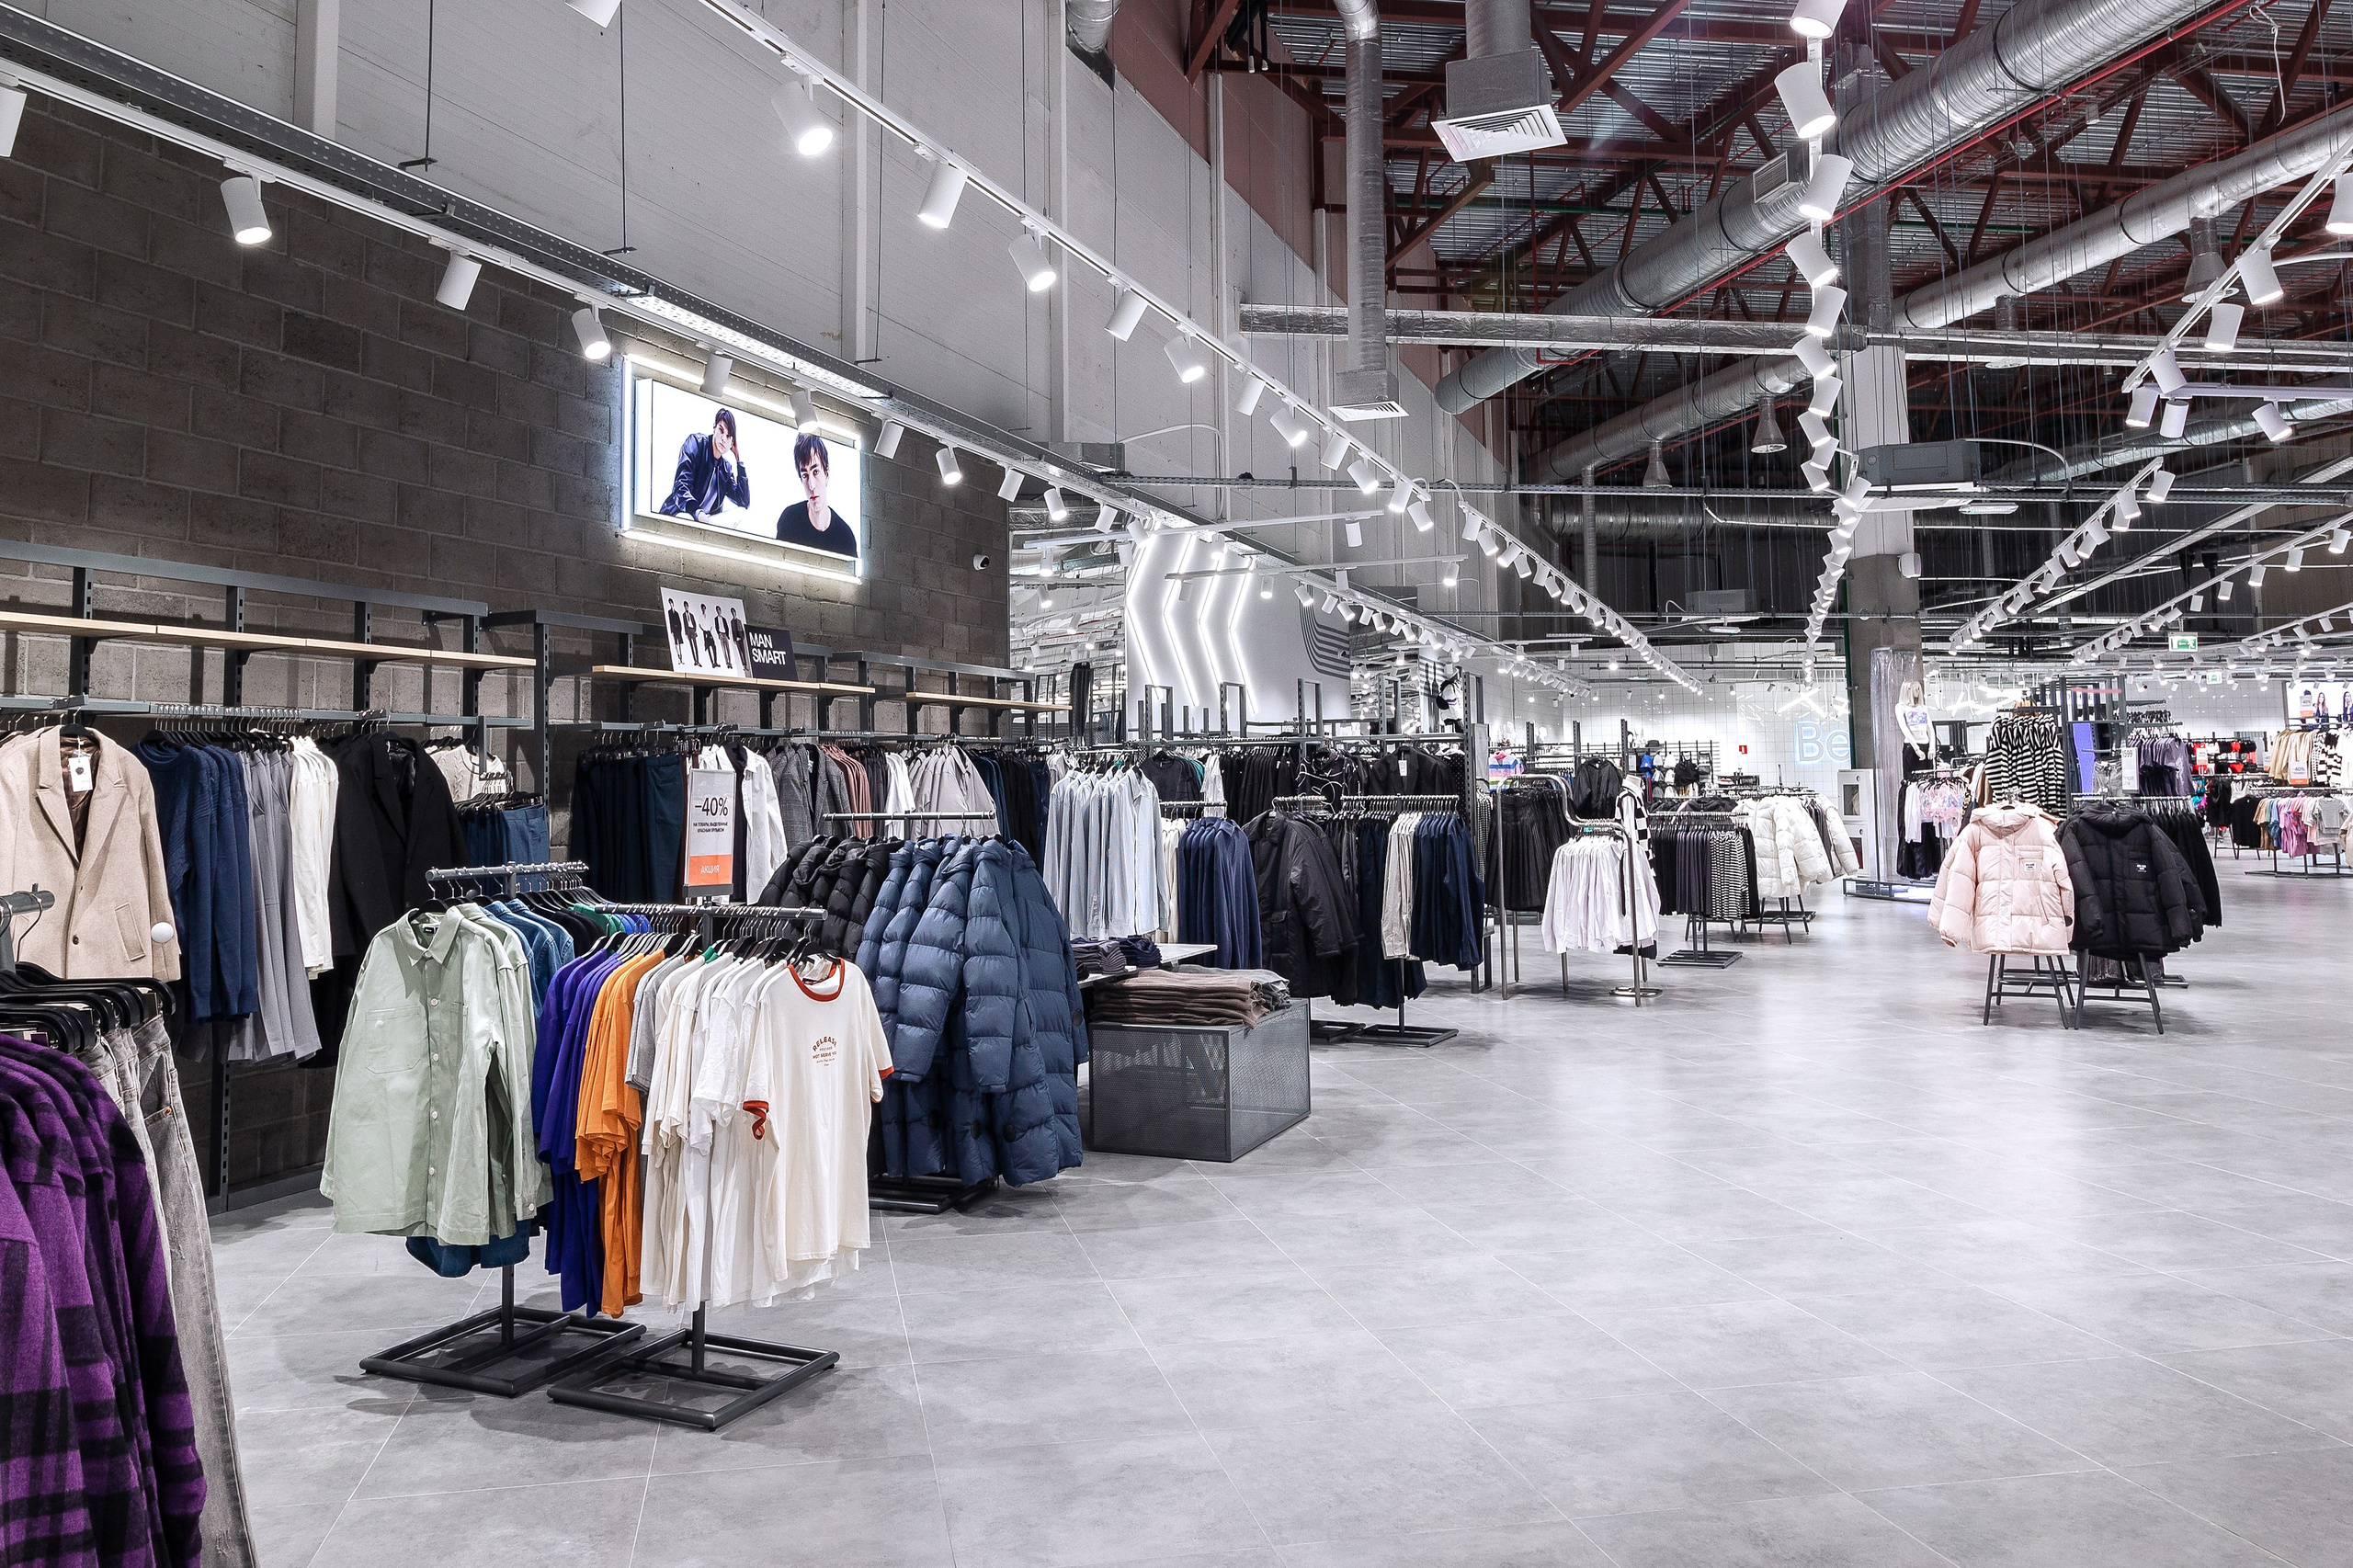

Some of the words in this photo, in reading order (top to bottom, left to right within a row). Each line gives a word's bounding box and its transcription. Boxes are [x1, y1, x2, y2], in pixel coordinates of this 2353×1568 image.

[749, 632, 773, 648] MAN
[752, 648, 786, 665] SMART
[695, 797, 728, 816] -40%
[700, 865, 720, 874] АКЦИЯ
